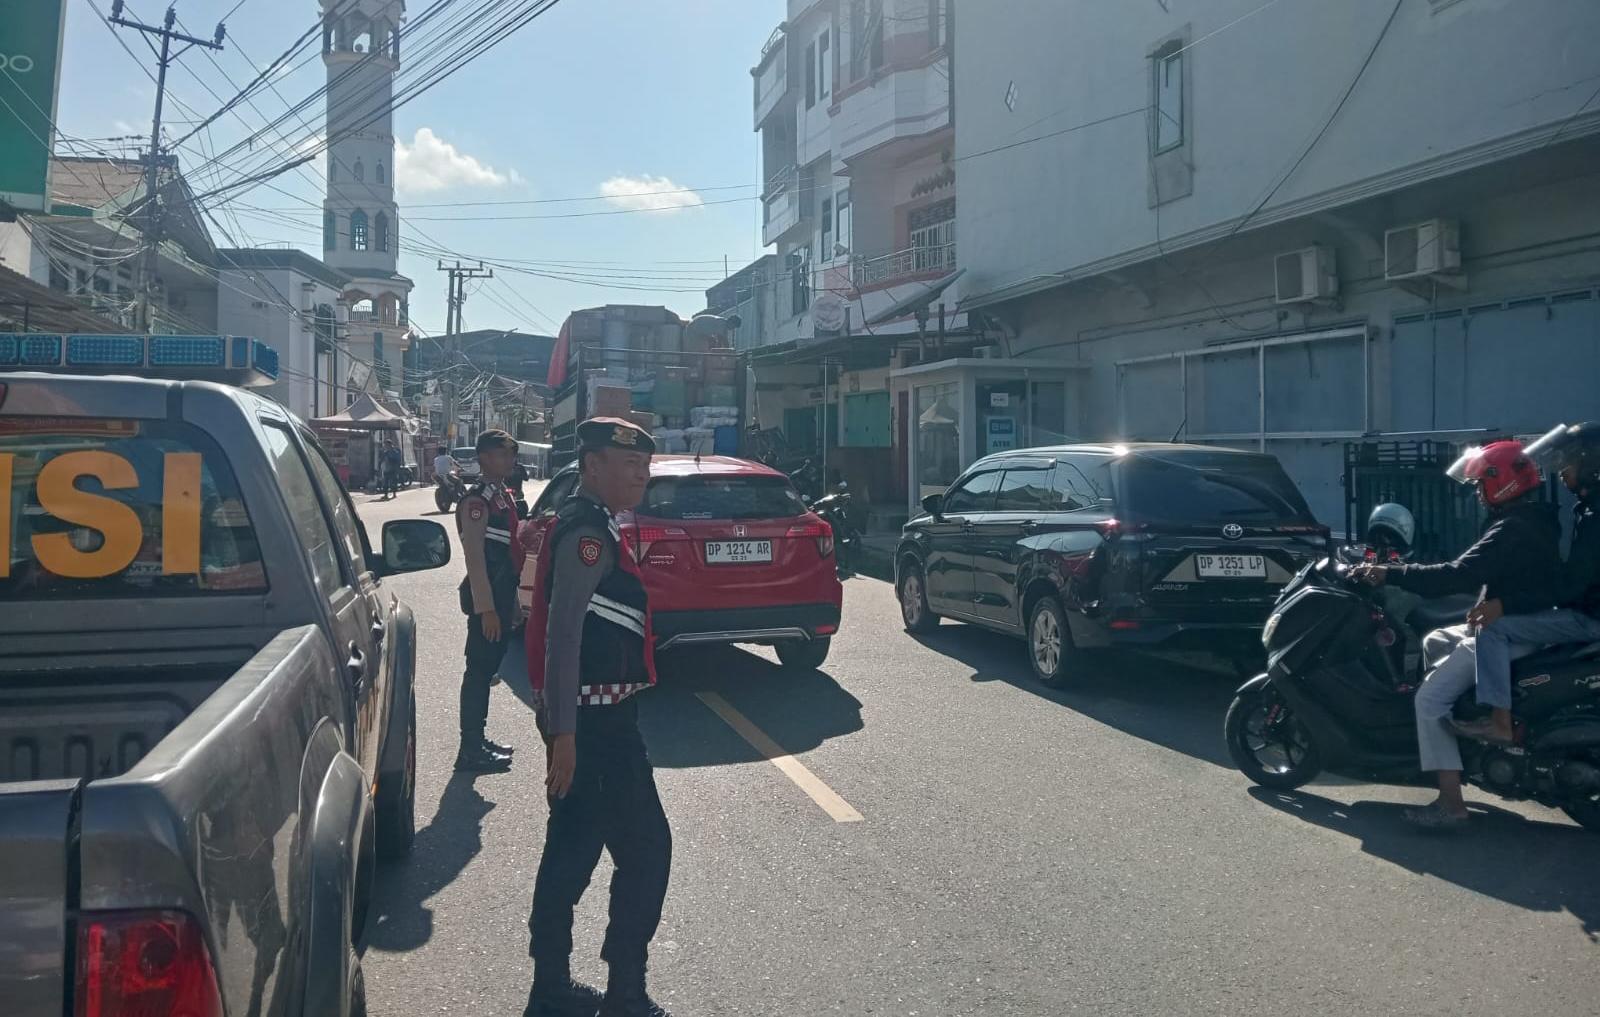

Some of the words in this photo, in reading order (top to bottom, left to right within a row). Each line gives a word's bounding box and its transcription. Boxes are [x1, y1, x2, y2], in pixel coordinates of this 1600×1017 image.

[708, 543, 721, 556] DP
[726, 542, 752, 555] 1214
[757, 542, 769, 555] AR
[1200, 557, 1213, 569] DP
[1218, 557, 1244, 570] 1251
[1250, 557, 1262, 570] LP
